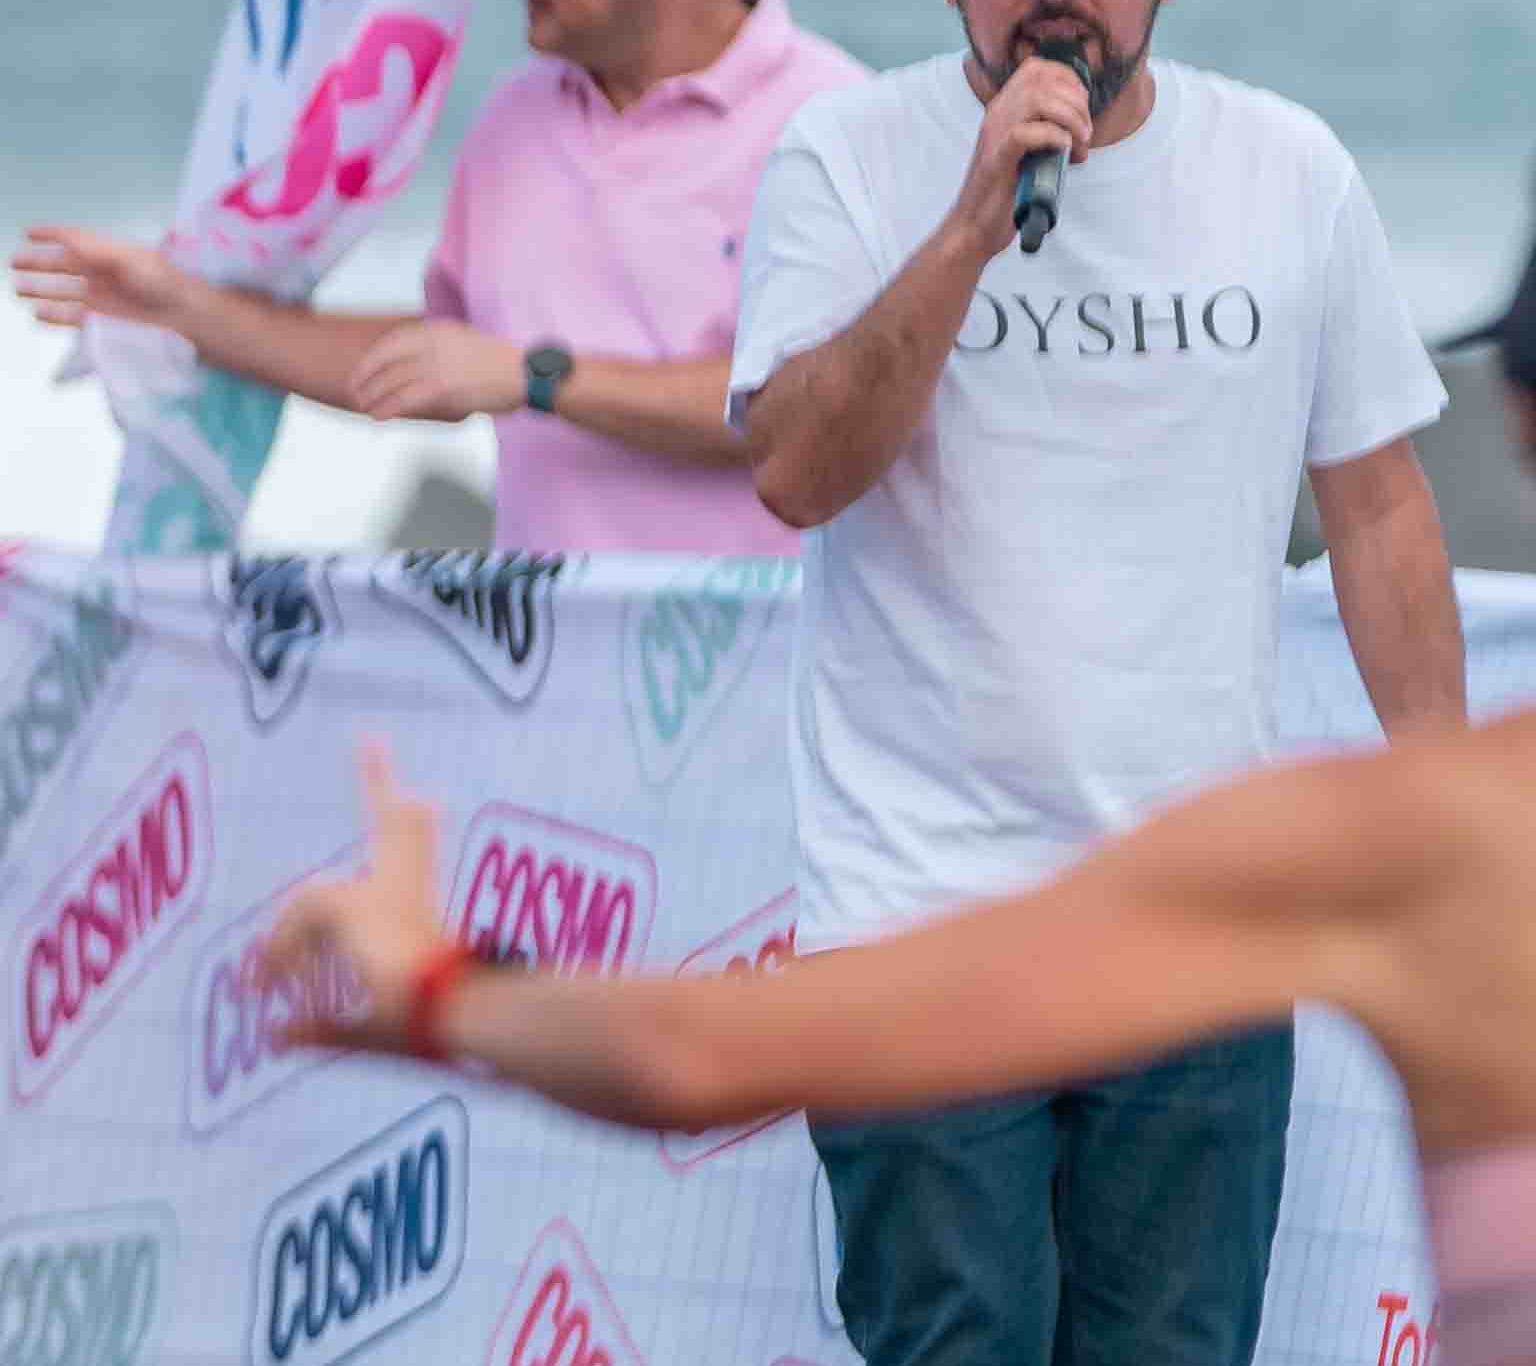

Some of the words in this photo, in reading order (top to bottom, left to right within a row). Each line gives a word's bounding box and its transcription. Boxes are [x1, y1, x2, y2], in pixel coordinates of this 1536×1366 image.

[952, 285, 1262, 355] OYSHO
[25, 773, 191, 1059] COSMO
[268, 1130, 449, 1361] COSMO
